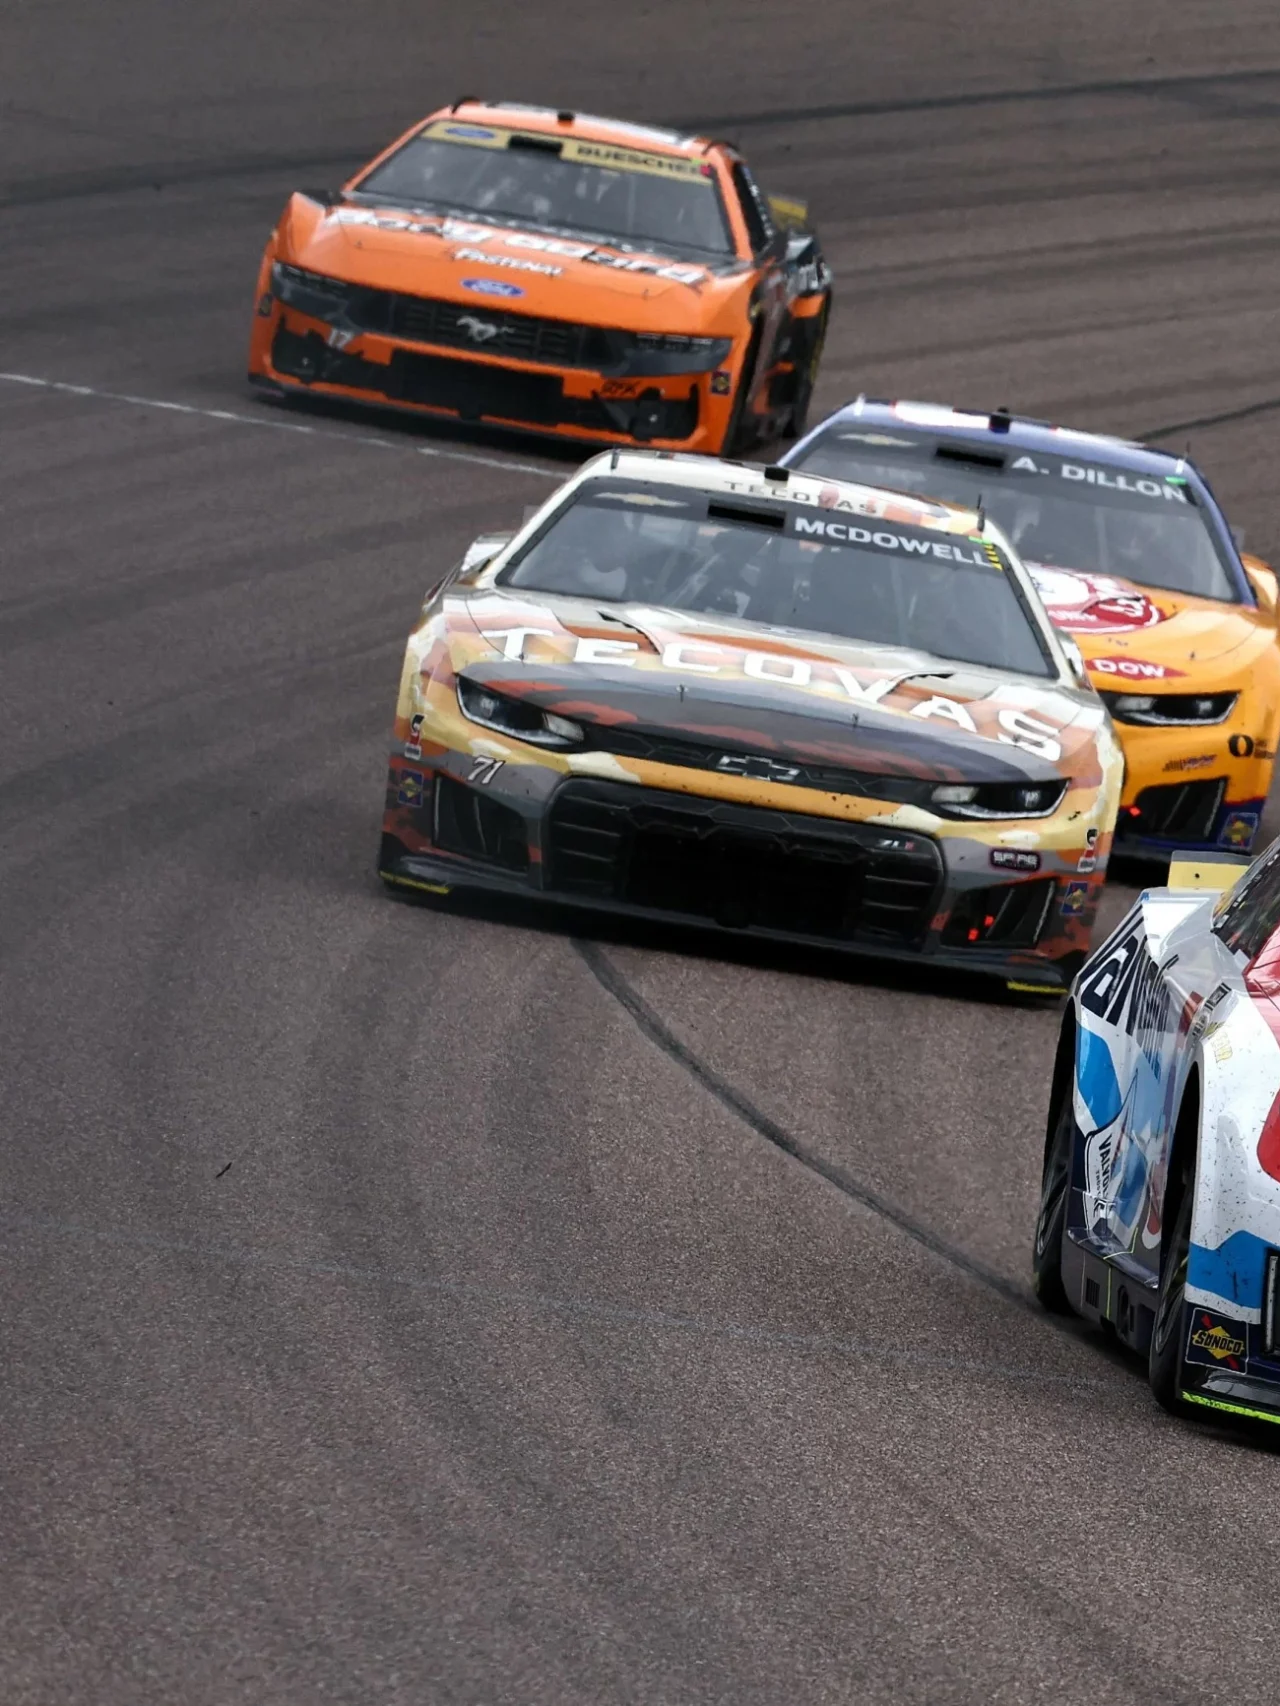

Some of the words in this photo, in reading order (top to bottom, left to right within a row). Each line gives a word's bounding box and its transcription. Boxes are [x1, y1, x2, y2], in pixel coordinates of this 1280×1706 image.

[723, 480, 878, 514] TECOVAS
[1011, 456, 1050, 475] A.
[1060, 463, 1188, 504] DILLON
[794, 516, 996, 568] MCDOWELL
[1091, 658, 1166, 678] DOW
[479, 626, 1063, 762] TECOVAS
[467, 755, 506, 784] 71
[1194, 1330, 1243, 1354] SUNOCO
